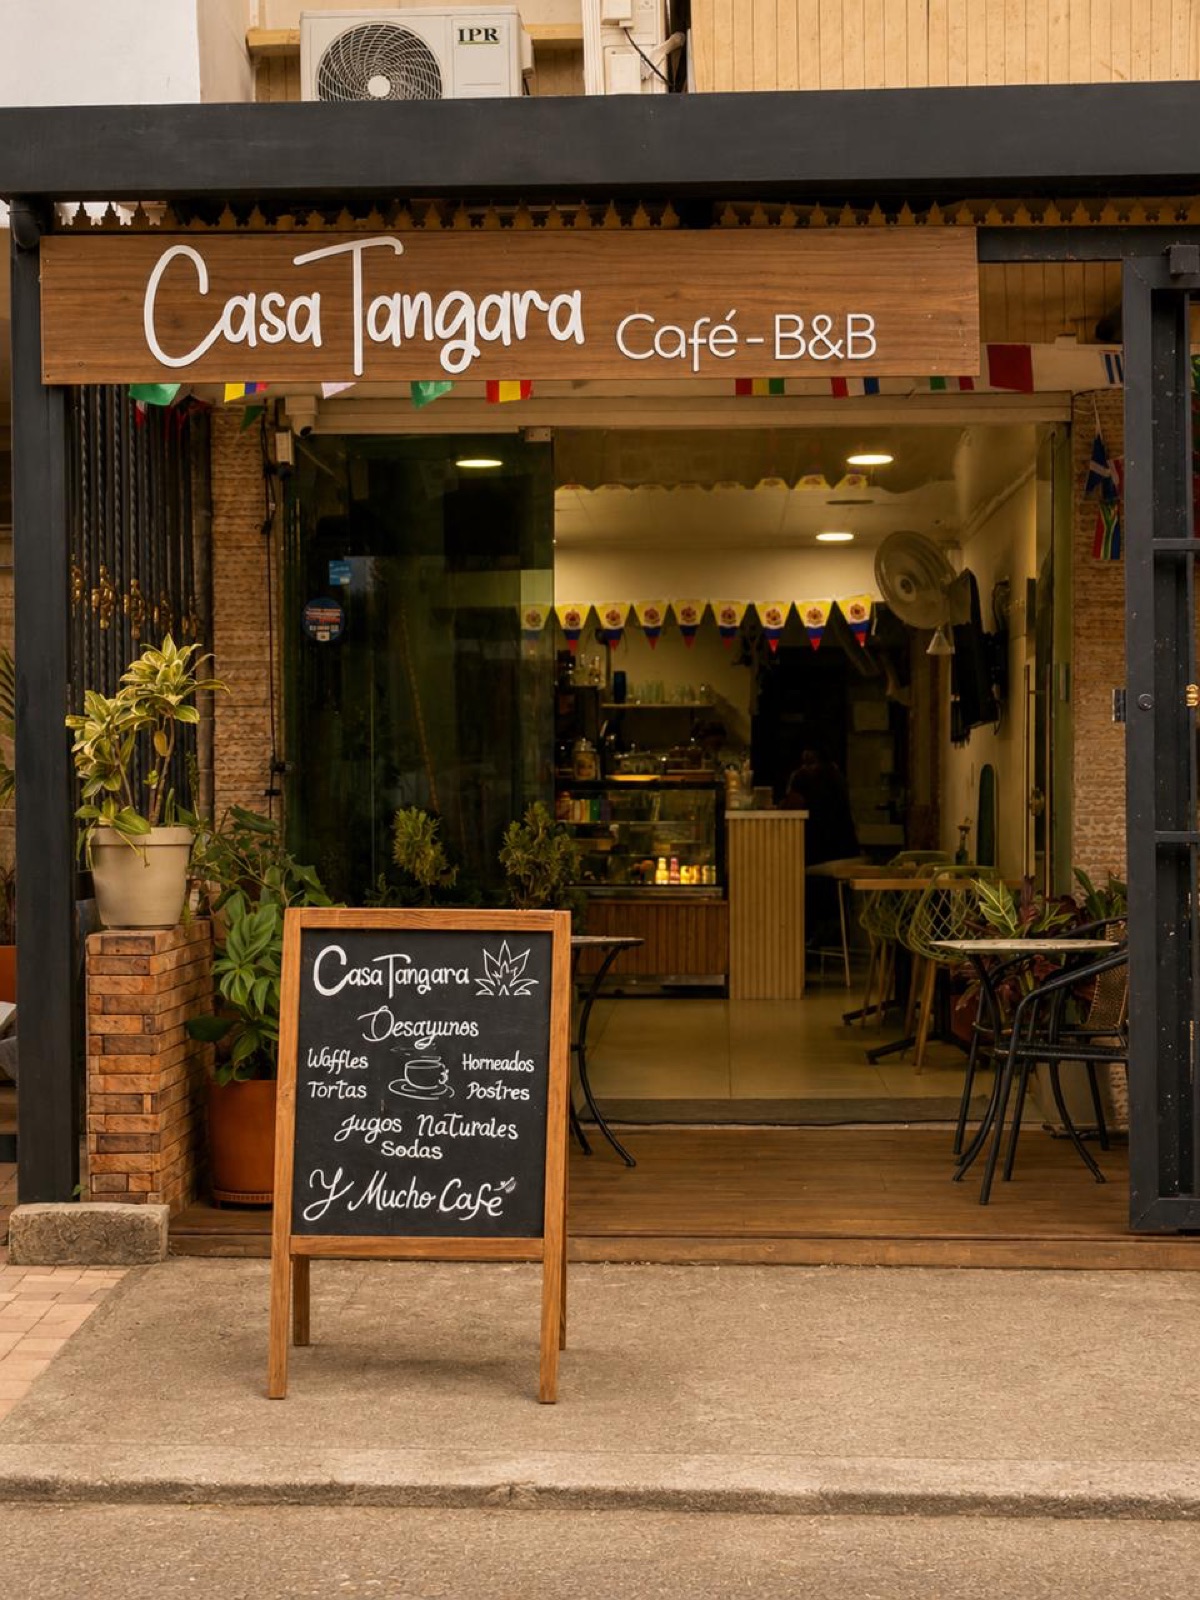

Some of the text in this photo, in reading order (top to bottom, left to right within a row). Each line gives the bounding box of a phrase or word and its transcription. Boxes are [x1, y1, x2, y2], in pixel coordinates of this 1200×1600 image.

[459, 28, 499, 42] IPR
[143, 236, 586, 377] Casa Tangara
[615, 308, 739, 373] Café
[774, 312, 878, 361] B&B
[312, 944, 470, 1000] Casa Tangara
[356, 1004, 480, 1050] Desayunos
[307, 1045, 369, 1075] Waffles
[461, 1049, 535, 1073] Horneados
[307, 1079, 368, 1100] Tortas
[465, 1079, 531, 1101] Postres
[333, 1114, 403, 1144] Jugos
[380, 1138, 444, 1160] Sodas
[302, 1166, 355, 1222] Y
[347, 1169, 437, 1212] Mucho
